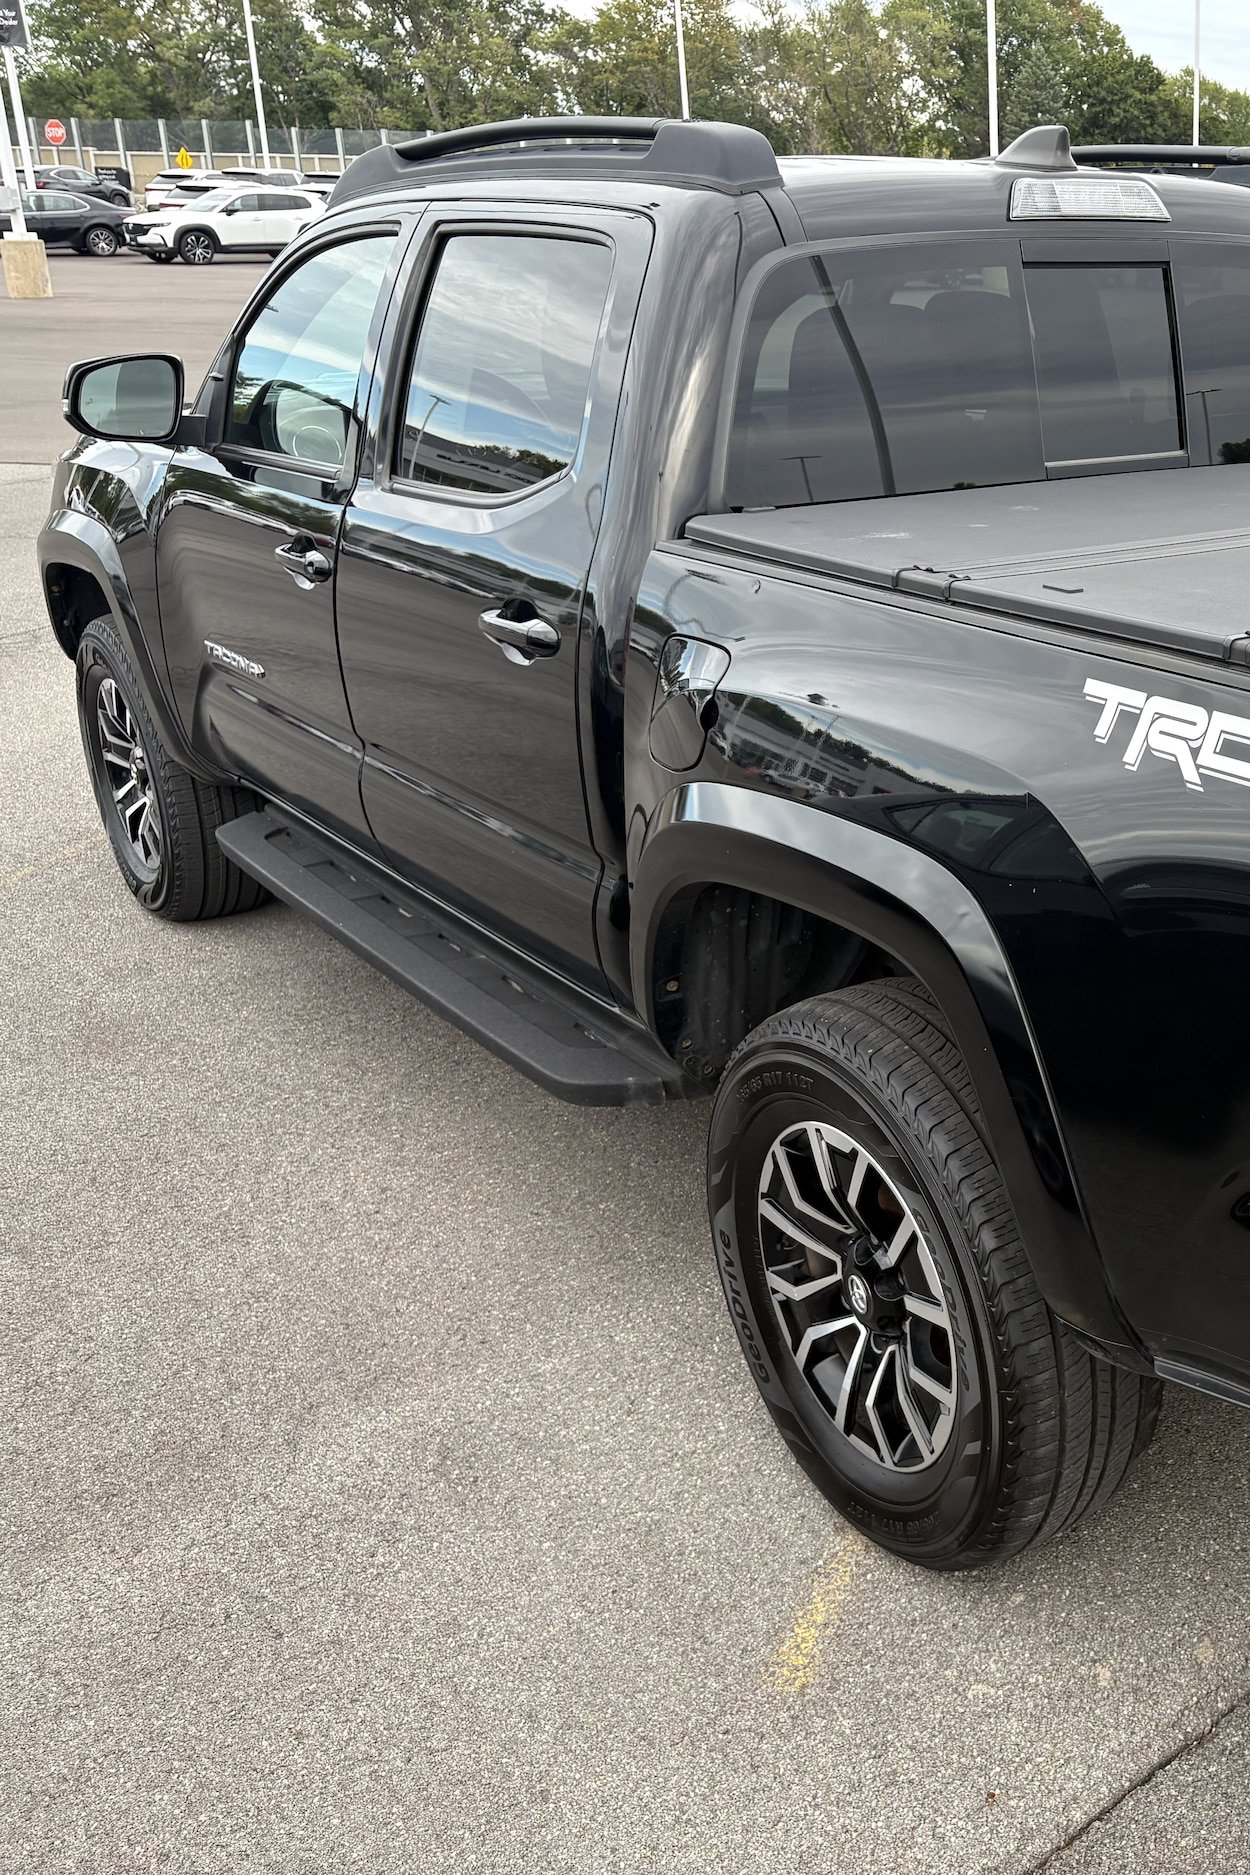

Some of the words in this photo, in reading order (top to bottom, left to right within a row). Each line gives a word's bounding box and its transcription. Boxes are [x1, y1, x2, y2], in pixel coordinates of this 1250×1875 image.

[47, 127, 65, 137] STOP
[203, 639, 265, 678] TACOMA
[718, 1229, 771, 1385] GeoDrive
